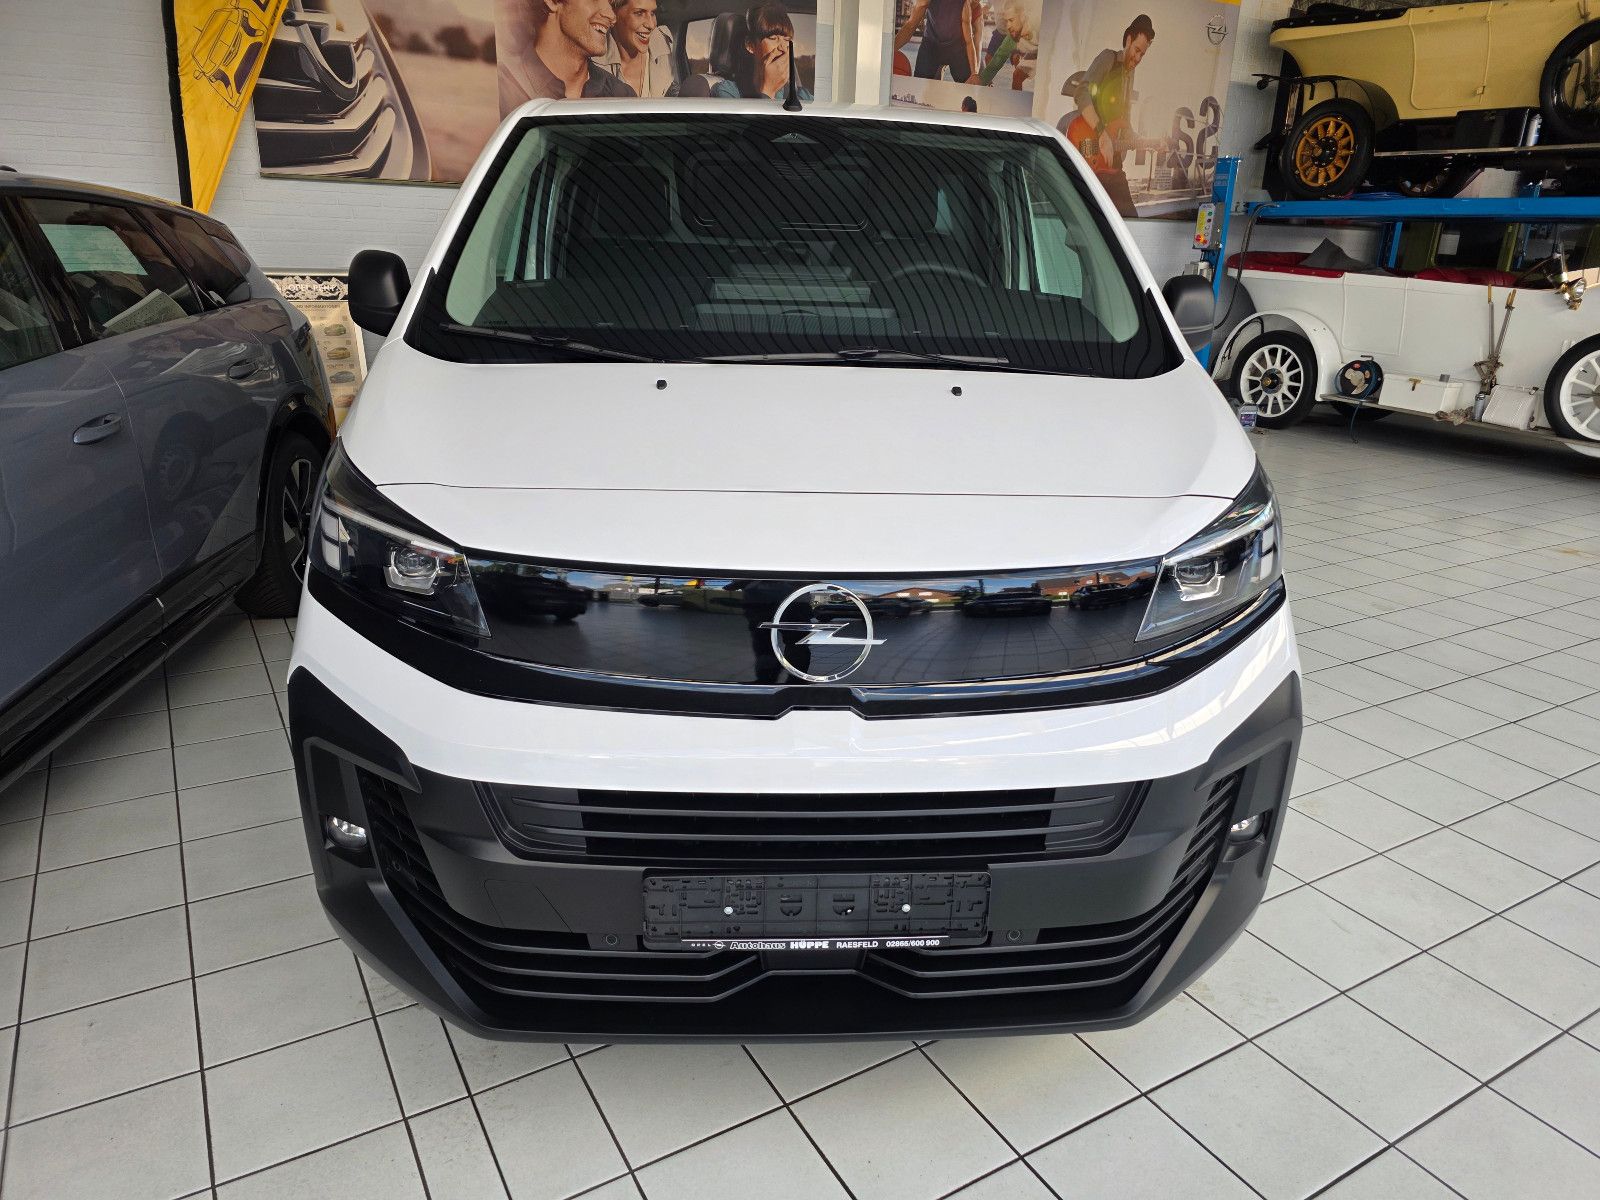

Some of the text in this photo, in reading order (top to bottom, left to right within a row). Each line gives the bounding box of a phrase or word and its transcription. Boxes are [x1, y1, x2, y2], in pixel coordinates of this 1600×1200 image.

[730, 941, 786, 949] Autohaus
[790, 939, 829, 949] HÜPPE
[836, 941, 879, 949] RAESFELD
[885, 940, 925, 948] 02865/600
